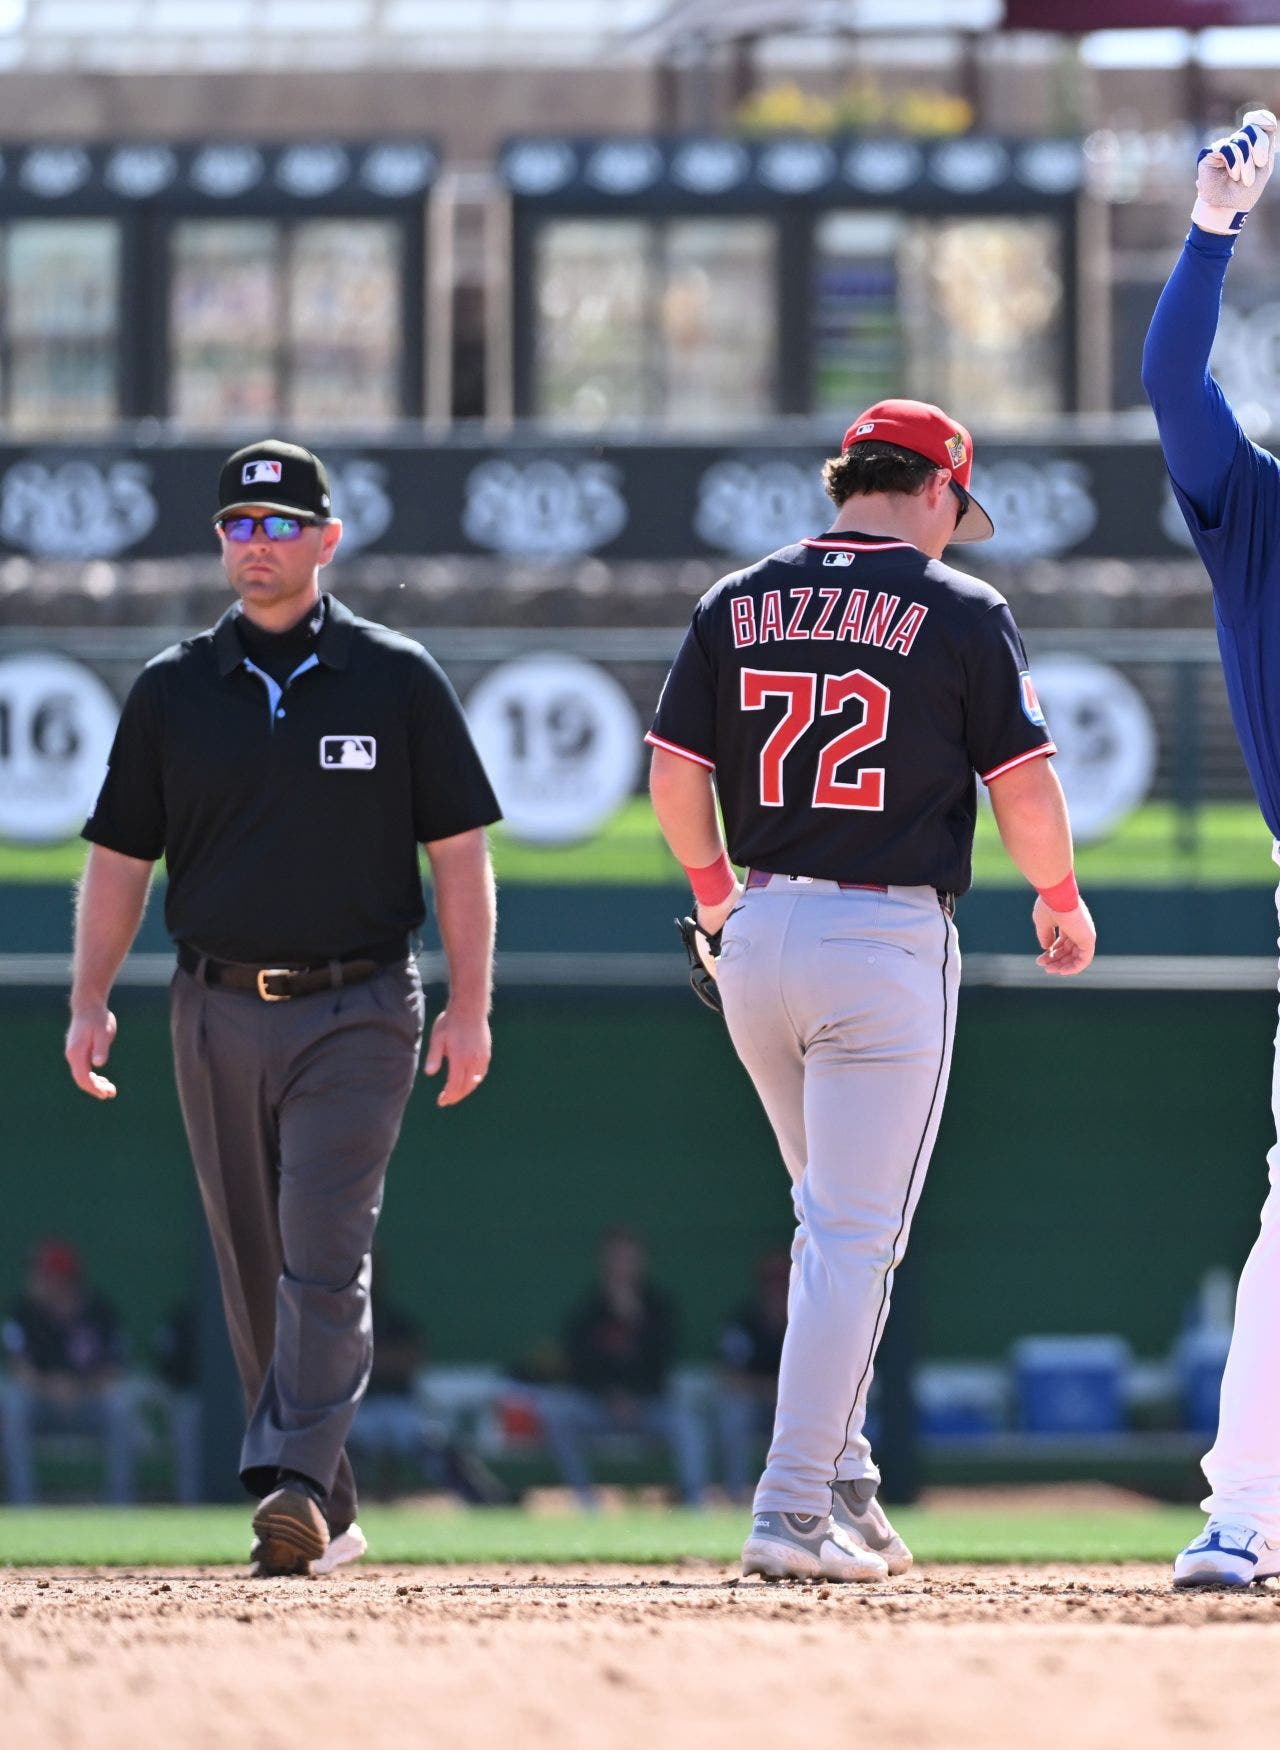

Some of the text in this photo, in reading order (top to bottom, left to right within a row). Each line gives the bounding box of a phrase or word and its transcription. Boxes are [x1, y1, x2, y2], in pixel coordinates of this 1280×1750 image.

[1237, 213, 1247, 228] 5
[730, 586, 928, 656] BAZZANA
[504, 692, 600, 770] 19
[740, 667, 890, 812] 72
